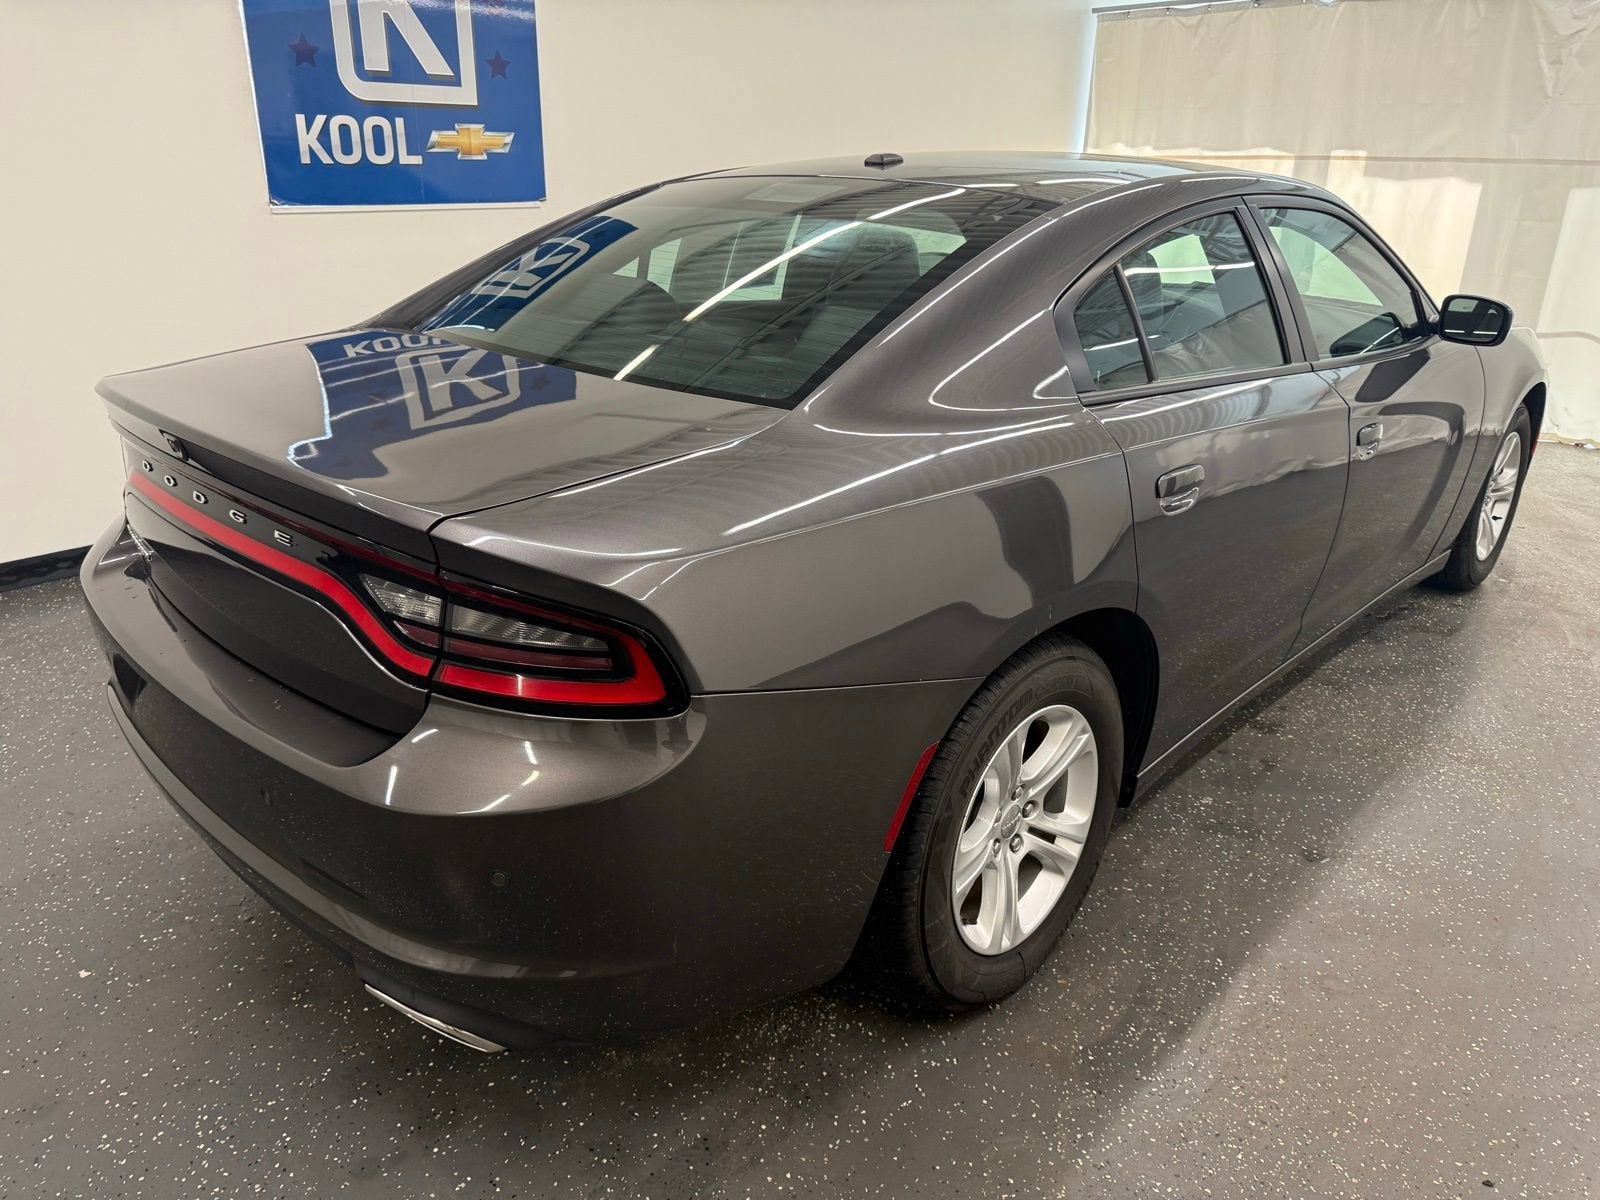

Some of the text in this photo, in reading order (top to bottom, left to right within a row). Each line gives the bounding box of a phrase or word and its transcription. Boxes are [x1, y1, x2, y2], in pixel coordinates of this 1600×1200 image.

[294, 113, 423, 166] KOOL
[141, 459, 294, 547] DODGE
[959, 687, 1034, 799] PHANTOM
